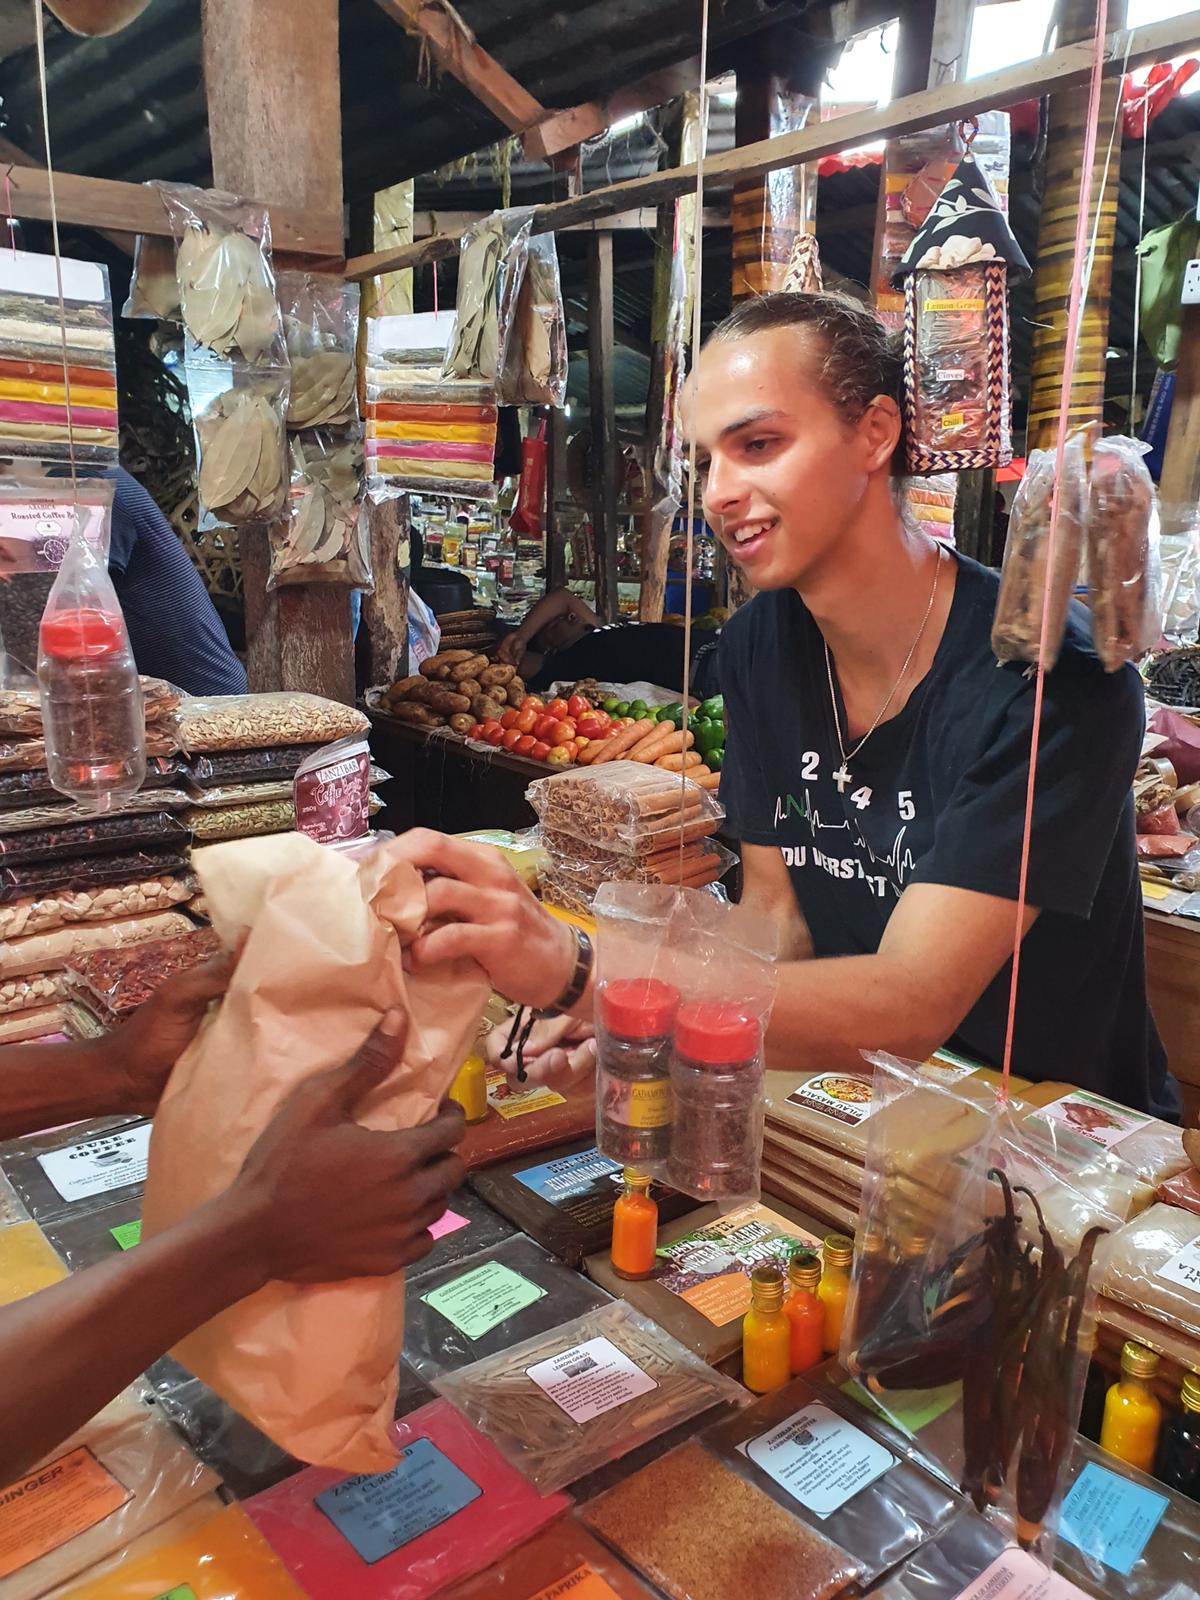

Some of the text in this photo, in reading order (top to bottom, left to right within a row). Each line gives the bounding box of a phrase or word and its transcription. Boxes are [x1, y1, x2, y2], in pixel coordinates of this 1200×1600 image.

[926, 301, 954, 311] Lemon
[11, 512, 41, 520] Roasted
[317, 760, 359, 782] ZANZIBAR
[801, 751, 916, 821] 2 4 5
[781, 846, 807, 867] DU
[801, 1090, 836, 1105] MASALA
[836, 1104, 863, 1117] PILAU
[69, 1138, 136, 1159] COFFEE
[76, 1136, 122, 1150] PURE
[544, 1161, 615, 1191] KILIMANJARO
[546, 1160, 573, 1173] BEST
[665, 1221, 735, 1257] BEST COFFEE
[672, 1220, 773, 1274] ZANZIBAR ARABICA
[735, 1238, 789, 1265] Coffee
[552, 1349, 579, 1363] ZANZIBAR
[552, 1351, 590, 1370] LEMON GRASS
[765, 1426, 793, 1444] ZANZIBAR
[0, 1465, 64, 1506] INGER
[361, 1468, 400, 1494] CURRY
[545, 1568, 592, 1600] PAPRIKA
